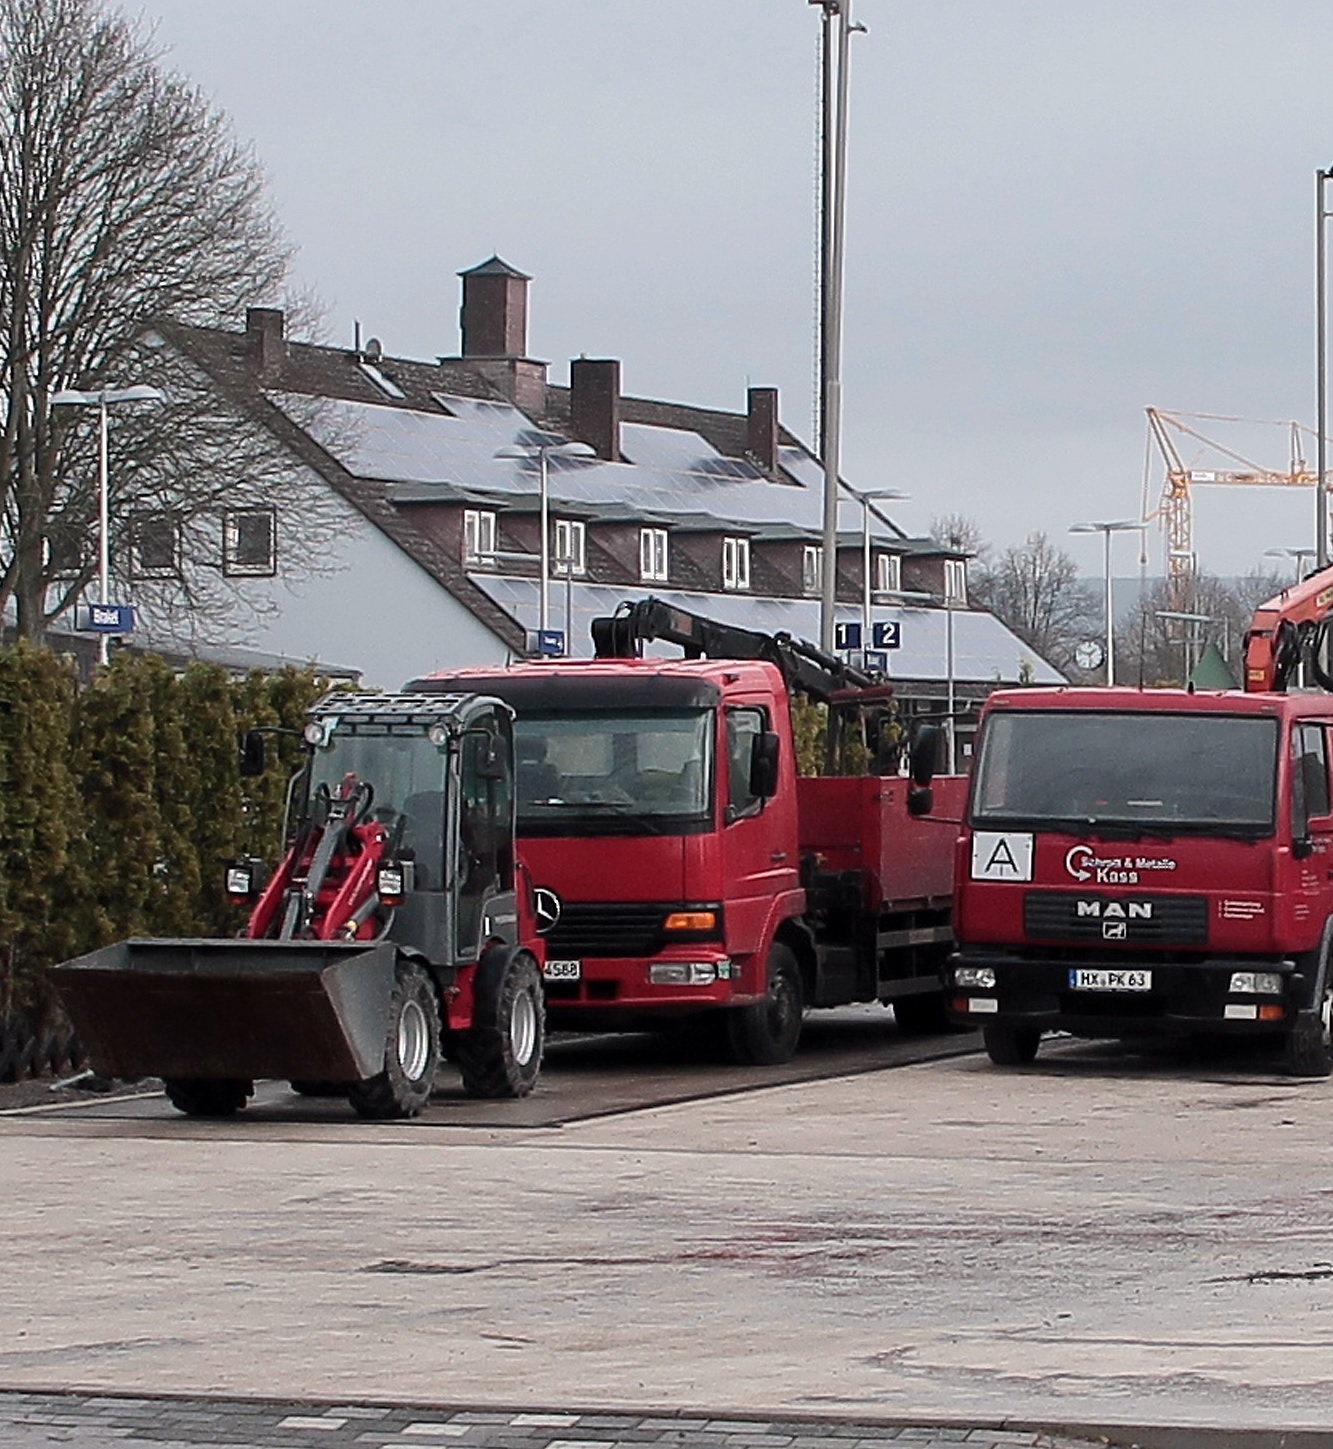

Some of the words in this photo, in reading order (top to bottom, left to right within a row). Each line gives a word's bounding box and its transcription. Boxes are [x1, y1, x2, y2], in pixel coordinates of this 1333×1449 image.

[837, 624, 847, 644] 1
[882, 623, 896, 644] 2
[984, 837, 1018, 874] A
[1076, 901, 1152, 919] MAN
[1081, 972, 1099, 986] HX
[1108, 972, 1127, 987] PK
[1128, 972, 1145, 987] 63
